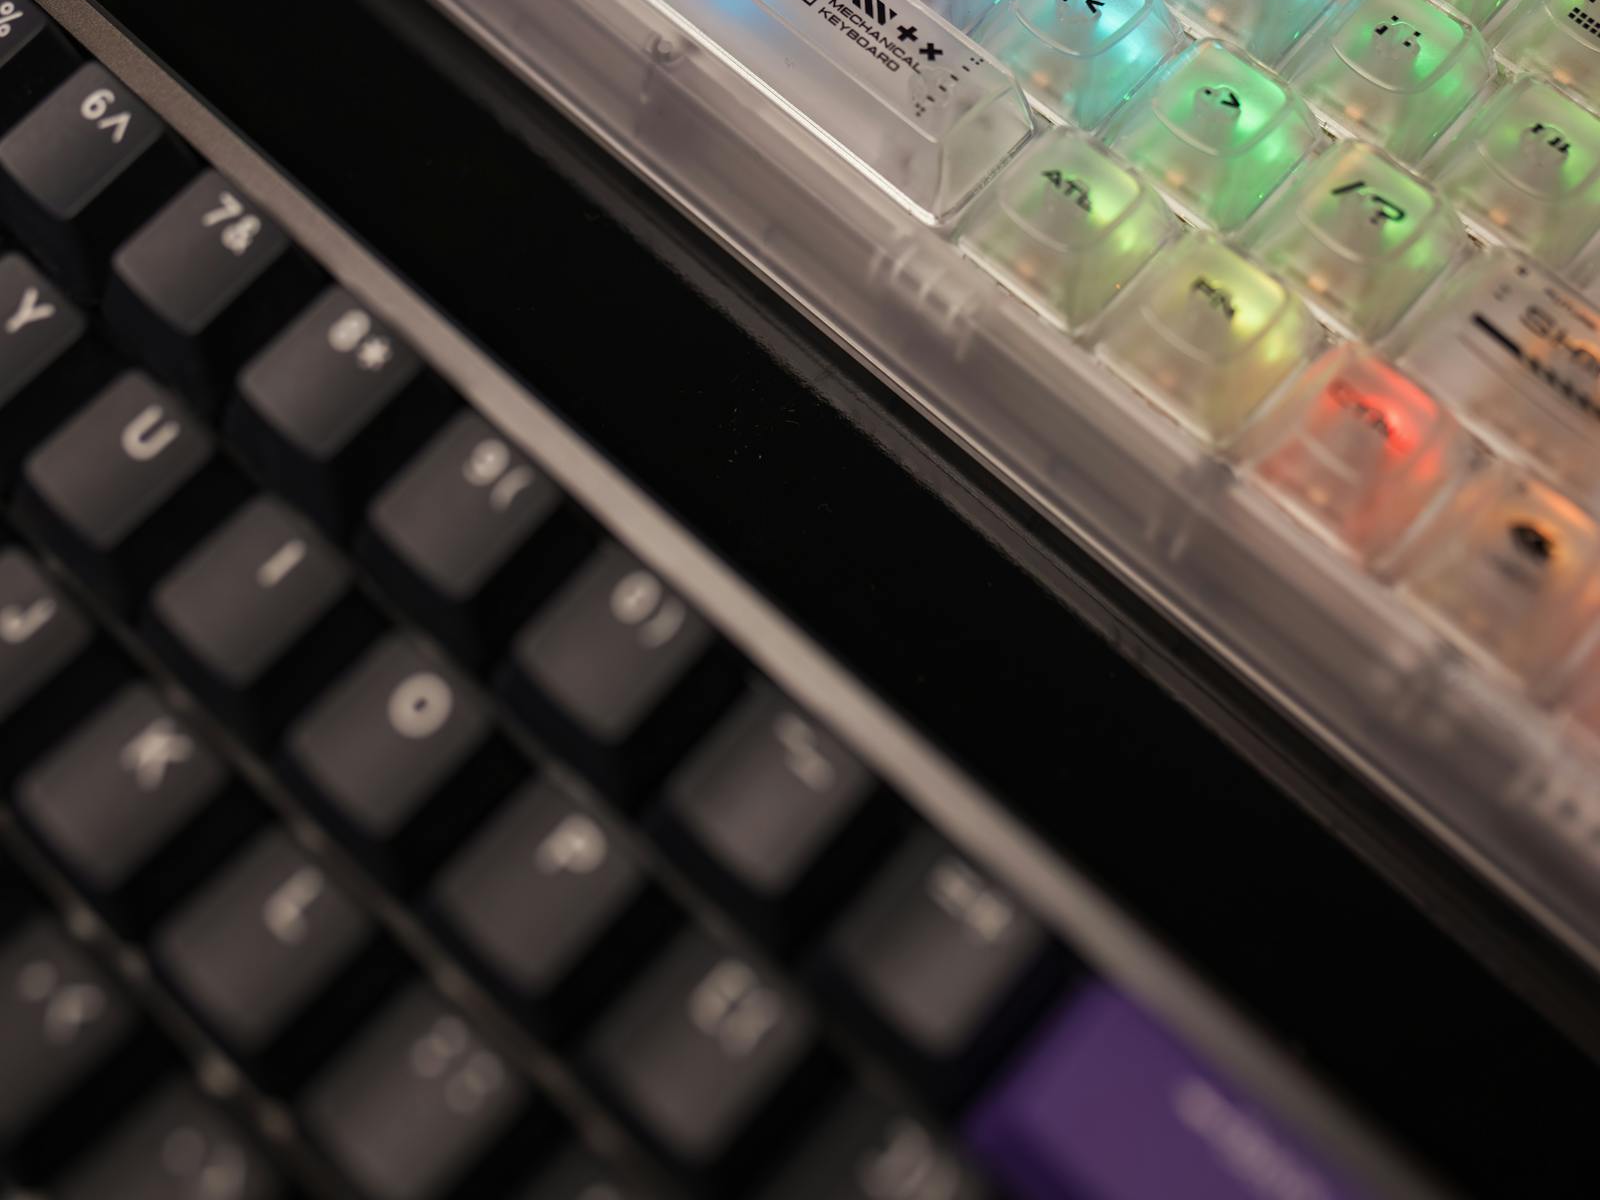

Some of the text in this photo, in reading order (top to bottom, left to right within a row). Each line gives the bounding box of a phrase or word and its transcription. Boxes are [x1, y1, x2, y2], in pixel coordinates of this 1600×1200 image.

[818, 6, 900, 72] KEYBOARD
[5, 287, 55, 334] Y
[121, 404, 181, 461] U
